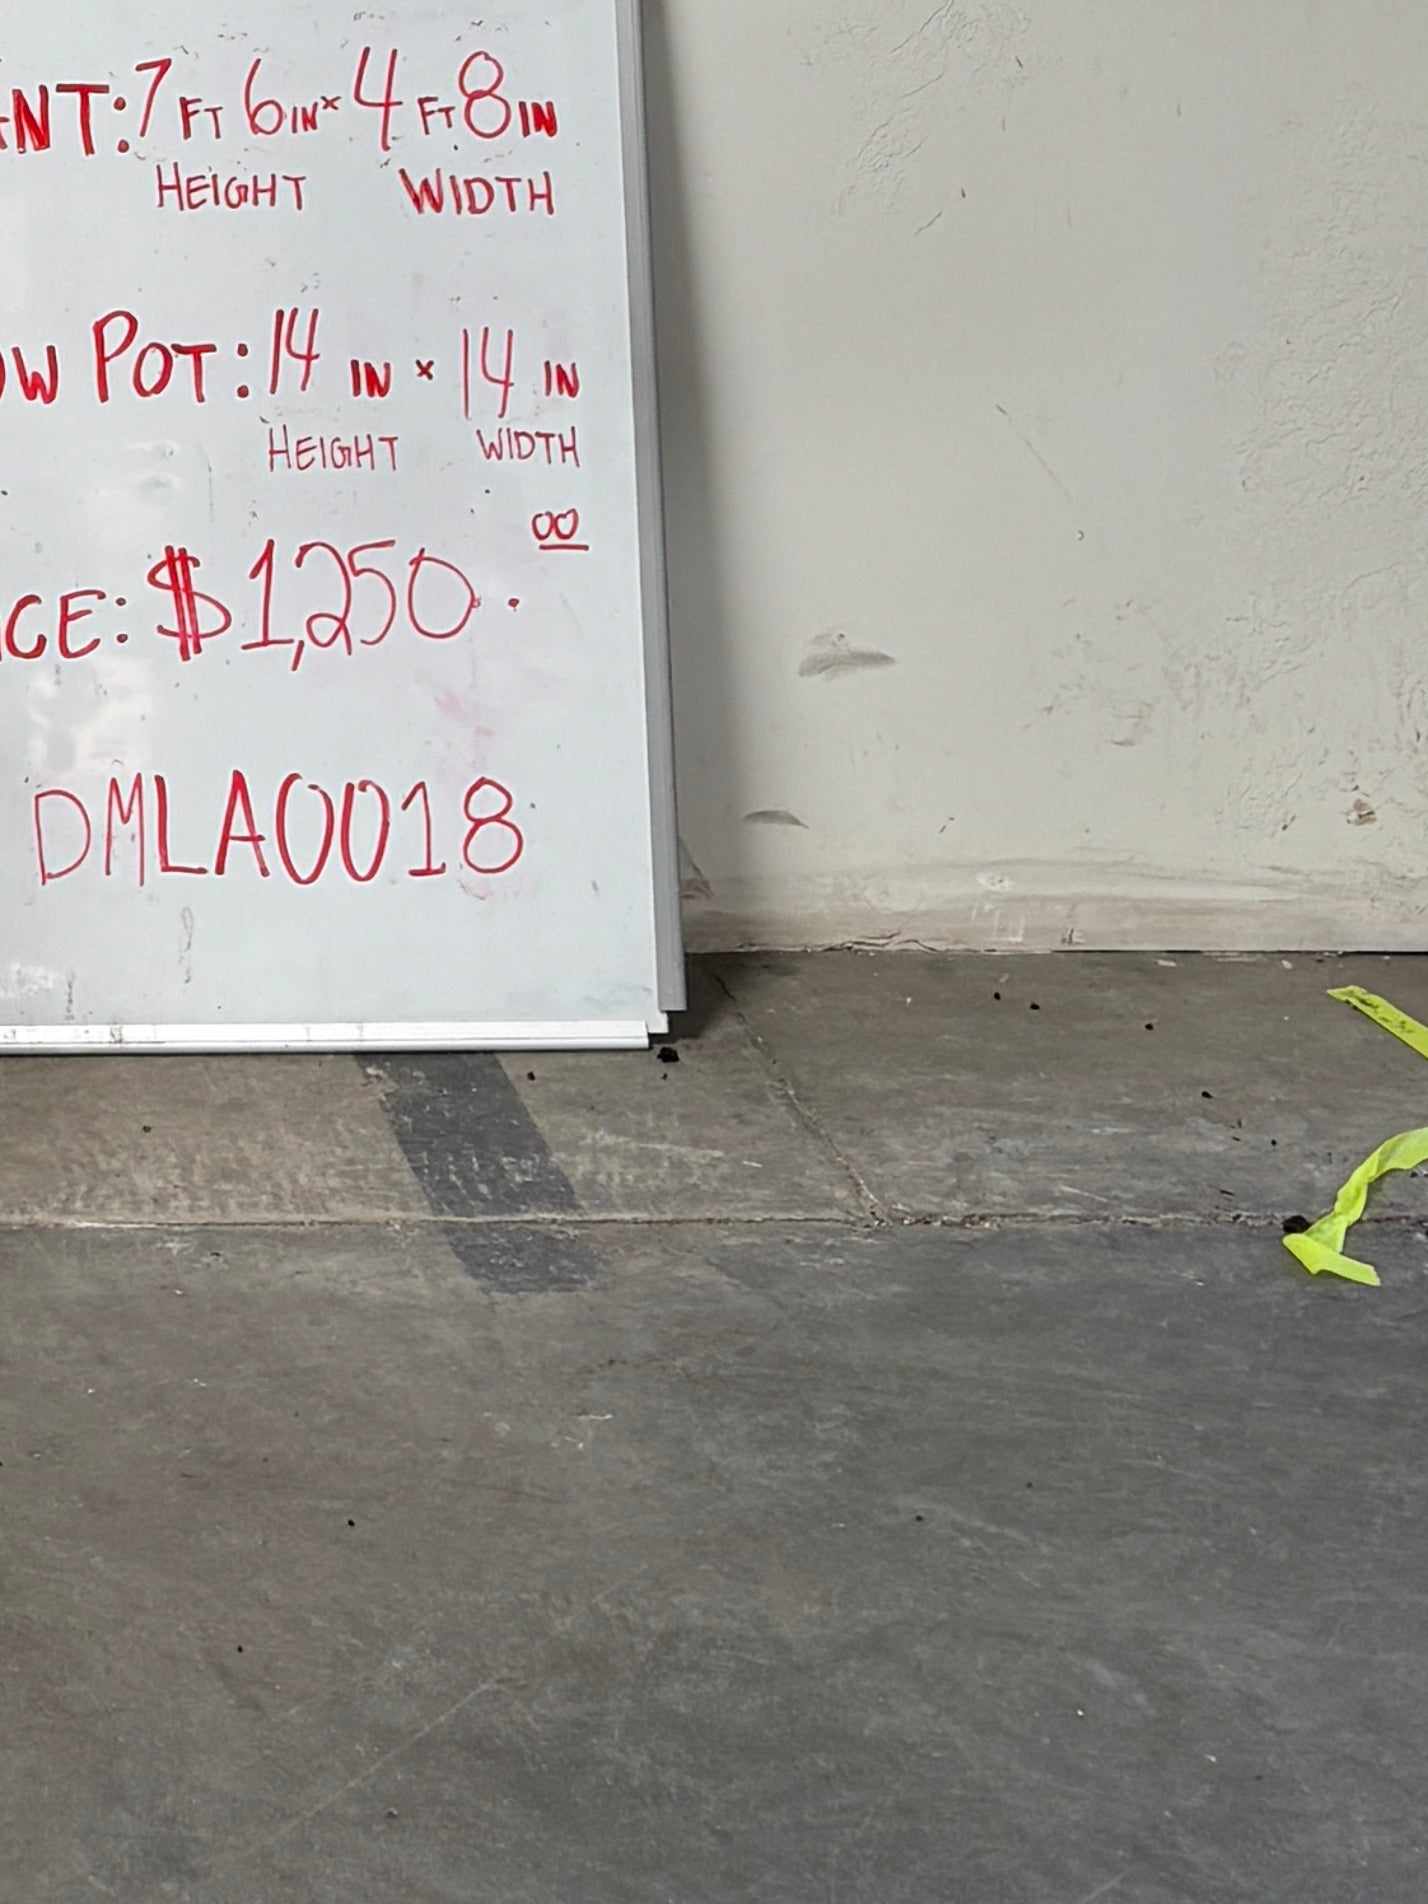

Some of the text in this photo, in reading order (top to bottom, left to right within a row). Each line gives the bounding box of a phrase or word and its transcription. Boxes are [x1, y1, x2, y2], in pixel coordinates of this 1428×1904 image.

[352, 46, 403, 153] 4
[155, 162, 556, 217] HEIGHT WIDTH
[89, 307, 249, 406] POT:
[267, 307, 321, 395] 14
[349, 358, 393, 400] IN
[461, 327, 515, 418] 14
[542, 360, 581, 399] IN
[267, 427, 582, 472] HEIGHT WIDTH
[32, 769, 525, 887] DMLA0018
